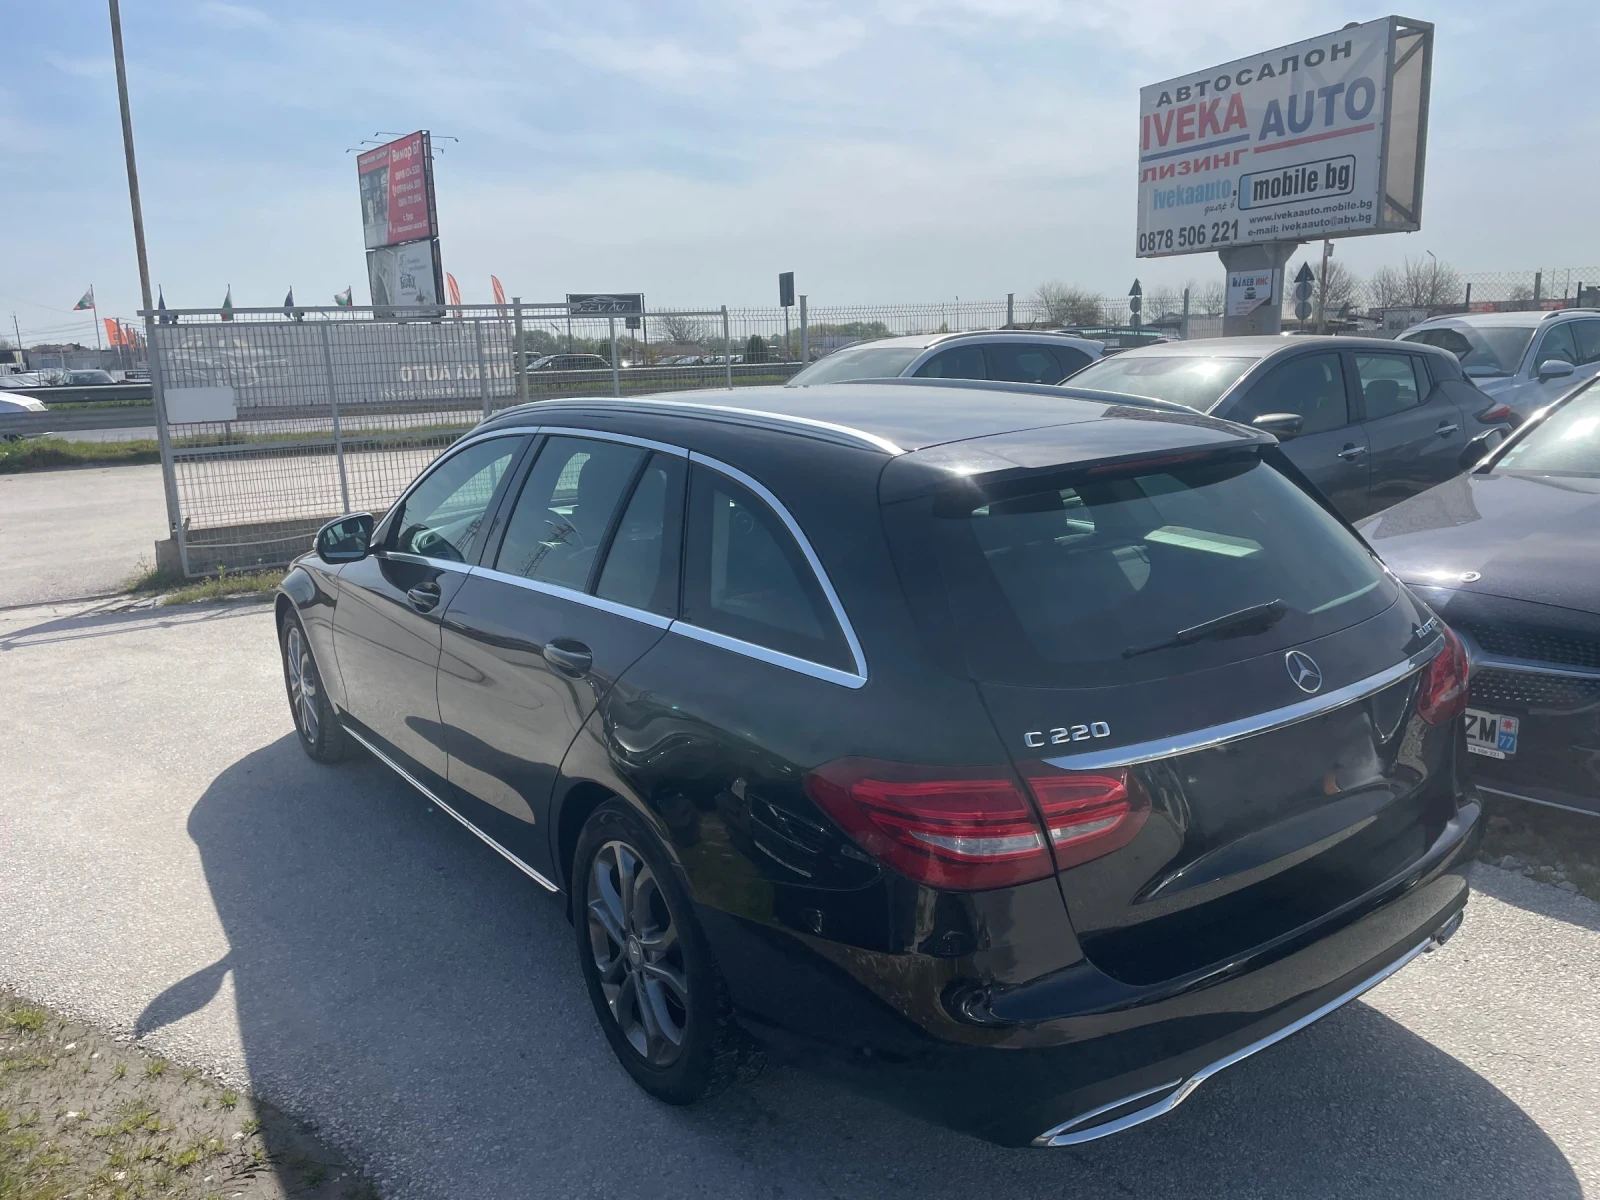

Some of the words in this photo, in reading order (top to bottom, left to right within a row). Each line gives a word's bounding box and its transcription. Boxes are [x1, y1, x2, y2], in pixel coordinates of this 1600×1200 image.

[1156, 40, 1352, 108] АВТОСАЛОН
[1143, 92, 1248, 151] IVEKA
[1258, 77, 1376, 141] AUTO
[1141, 148, 1249, 184] ЛИЗИНГ
[1253, 163, 1351, 202] mobile.bg
[1247, 224, 1279, 237] e-mail:
[1281, 213, 1372, 232] ivekaauto@abv.bg
[1248, 200, 1373, 224] www.ivekaauto.mobile.bg
[1139, 229, 1174, 253] 0878
[1178, 224, 1206, 248] 506
[1211, 219, 1239, 243] 221
[1024, 731, 1045, 748] C
[1049, 721, 1111, 745] 220
[1499, 735, 1514, 749] 77
